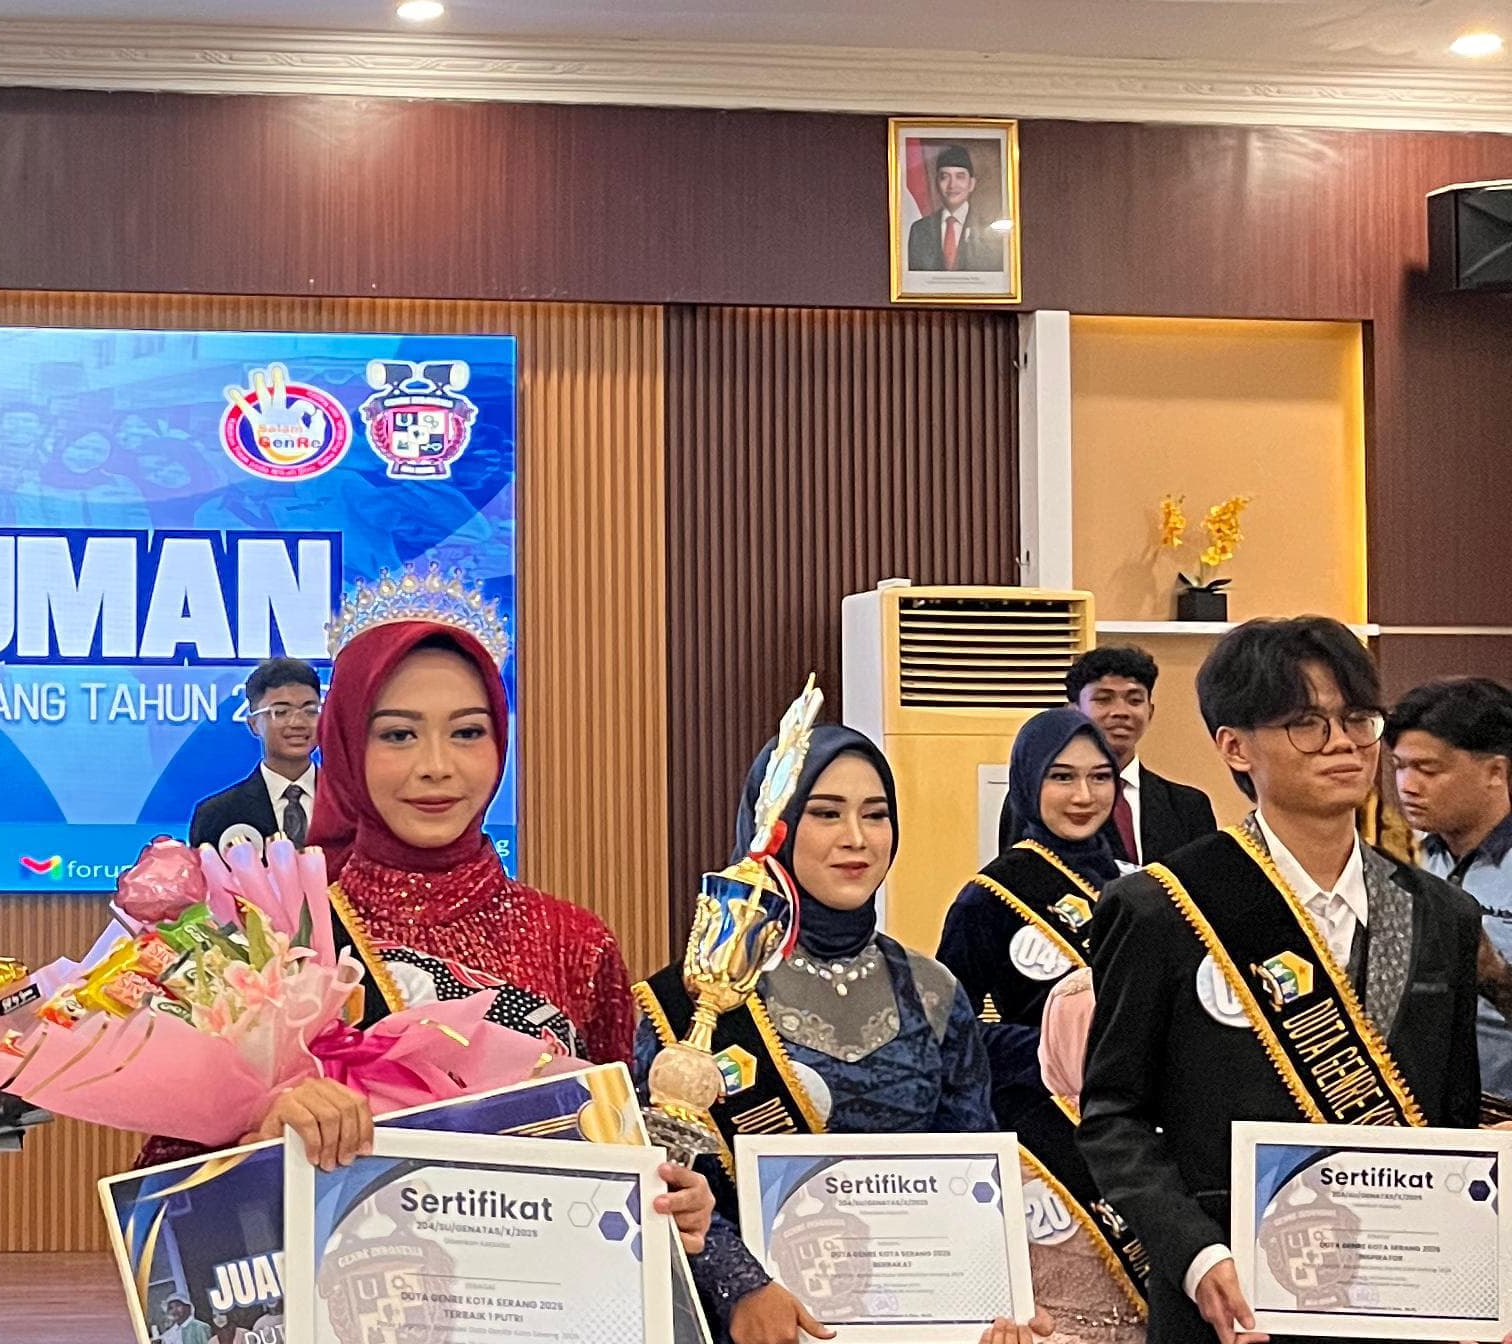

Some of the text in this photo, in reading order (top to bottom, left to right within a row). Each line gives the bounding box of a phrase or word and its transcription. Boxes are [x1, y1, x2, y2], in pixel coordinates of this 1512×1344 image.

[258, 436, 321, 449] GenRe
[81, 682, 218, 722] TAHUN
[1282, 997, 1350, 1062] DUTA
[1310, 1046, 1383, 1120] GENRE
[825, 1174, 938, 1195] Sertifikat
[1320, 1167, 1434, 1190] Sertifikat
[400, 1187, 553, 1222] Sertifikat
[466, 1295, 495, 1307] KOTA
[496, 1298, 538, 1310] SERANG
[494, 1312, 524, 1323] PUTRI
